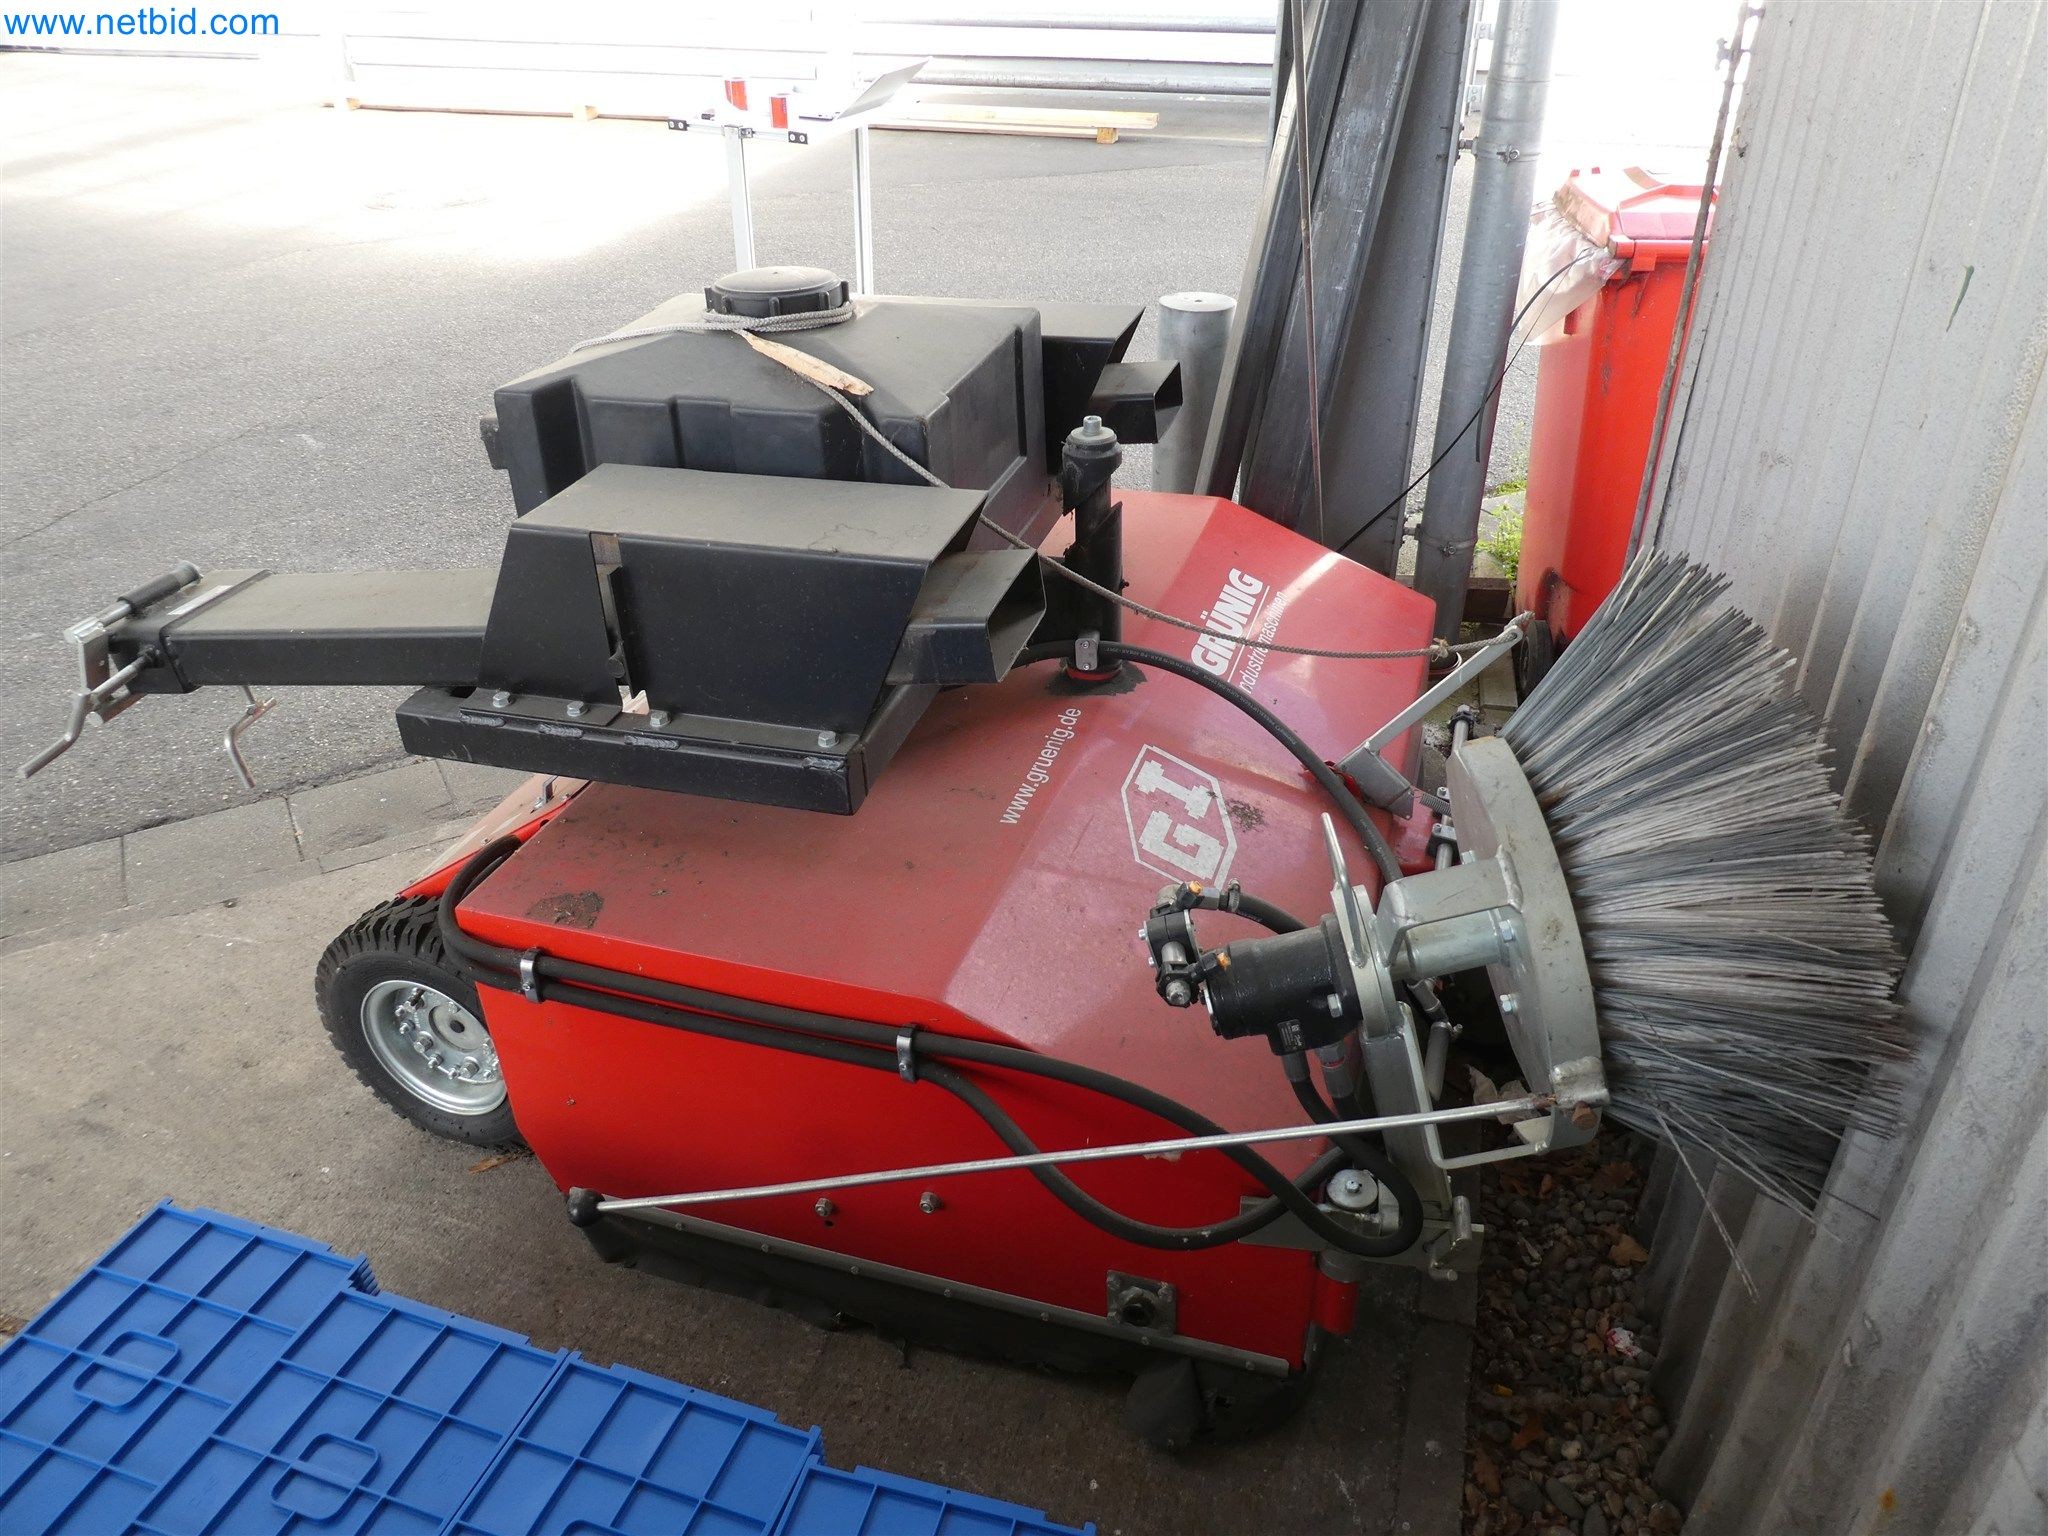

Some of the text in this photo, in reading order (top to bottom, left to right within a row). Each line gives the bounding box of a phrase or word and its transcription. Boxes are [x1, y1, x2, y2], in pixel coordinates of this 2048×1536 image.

[1191, 567, 1264, 676] GRÜNIG
[1238, 590, 1289, 695] ndustriemaschinen
[1000, 707, 1082, 825] www.gruenig.de
